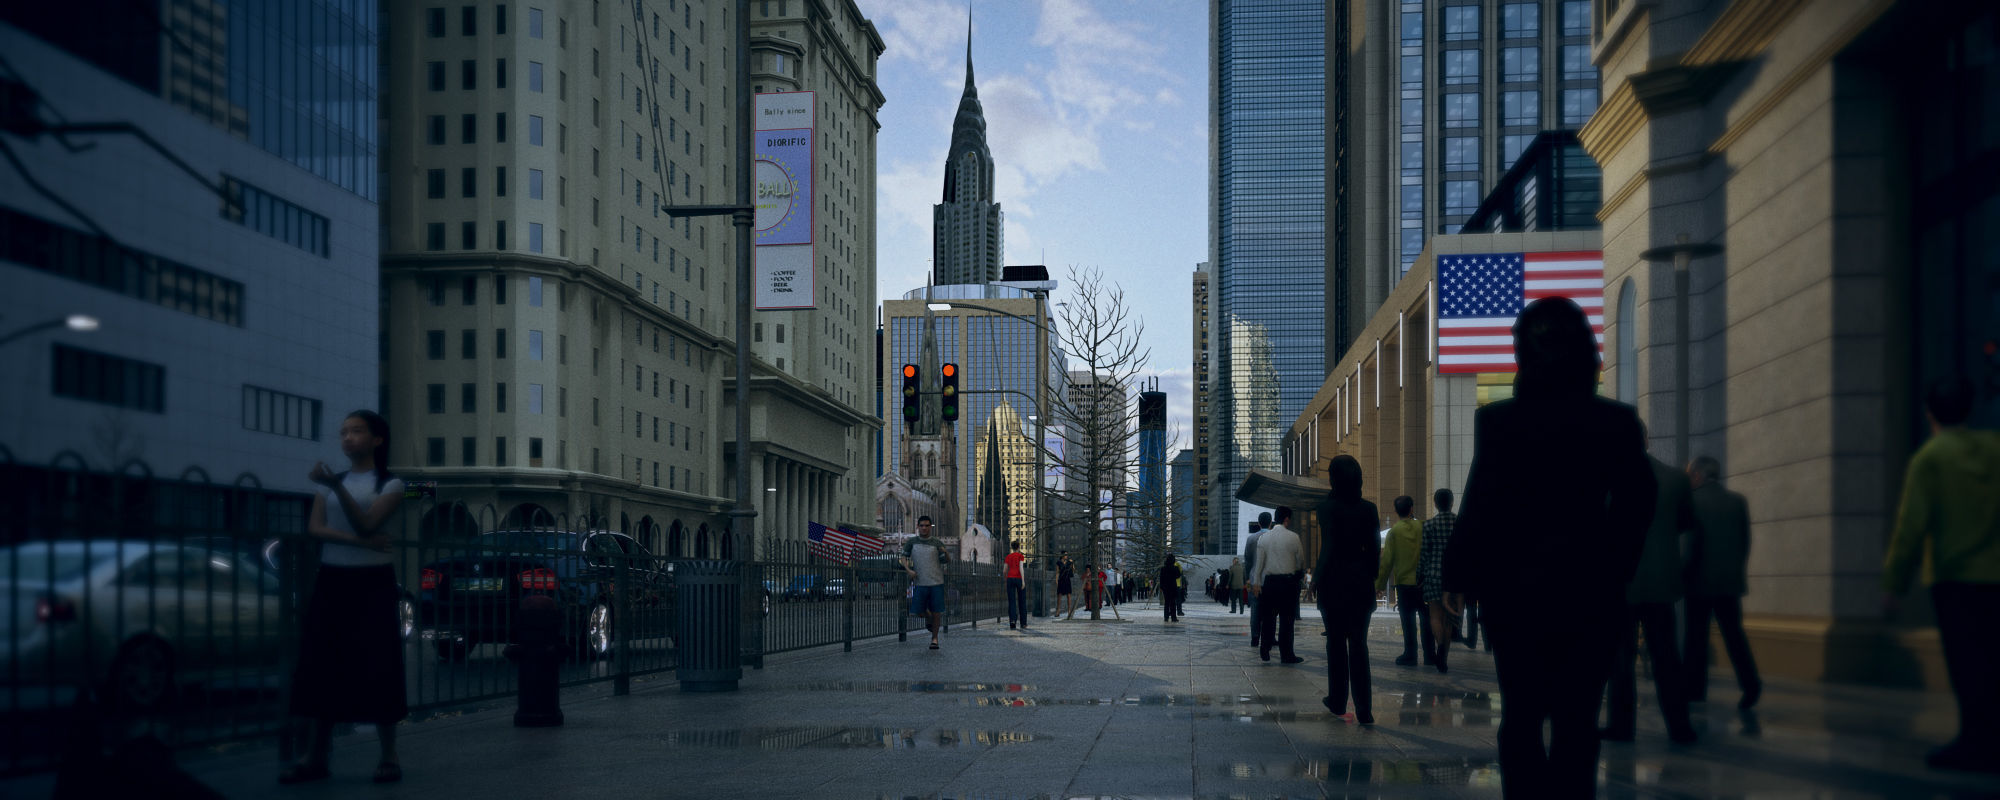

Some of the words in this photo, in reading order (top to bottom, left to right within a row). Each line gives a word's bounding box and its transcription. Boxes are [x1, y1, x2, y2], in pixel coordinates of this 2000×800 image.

[765, 108, 784, 116] Bally
[767, 138, 806, 147] DIORIFIC
[758, 180, 798, 196] BALLY
